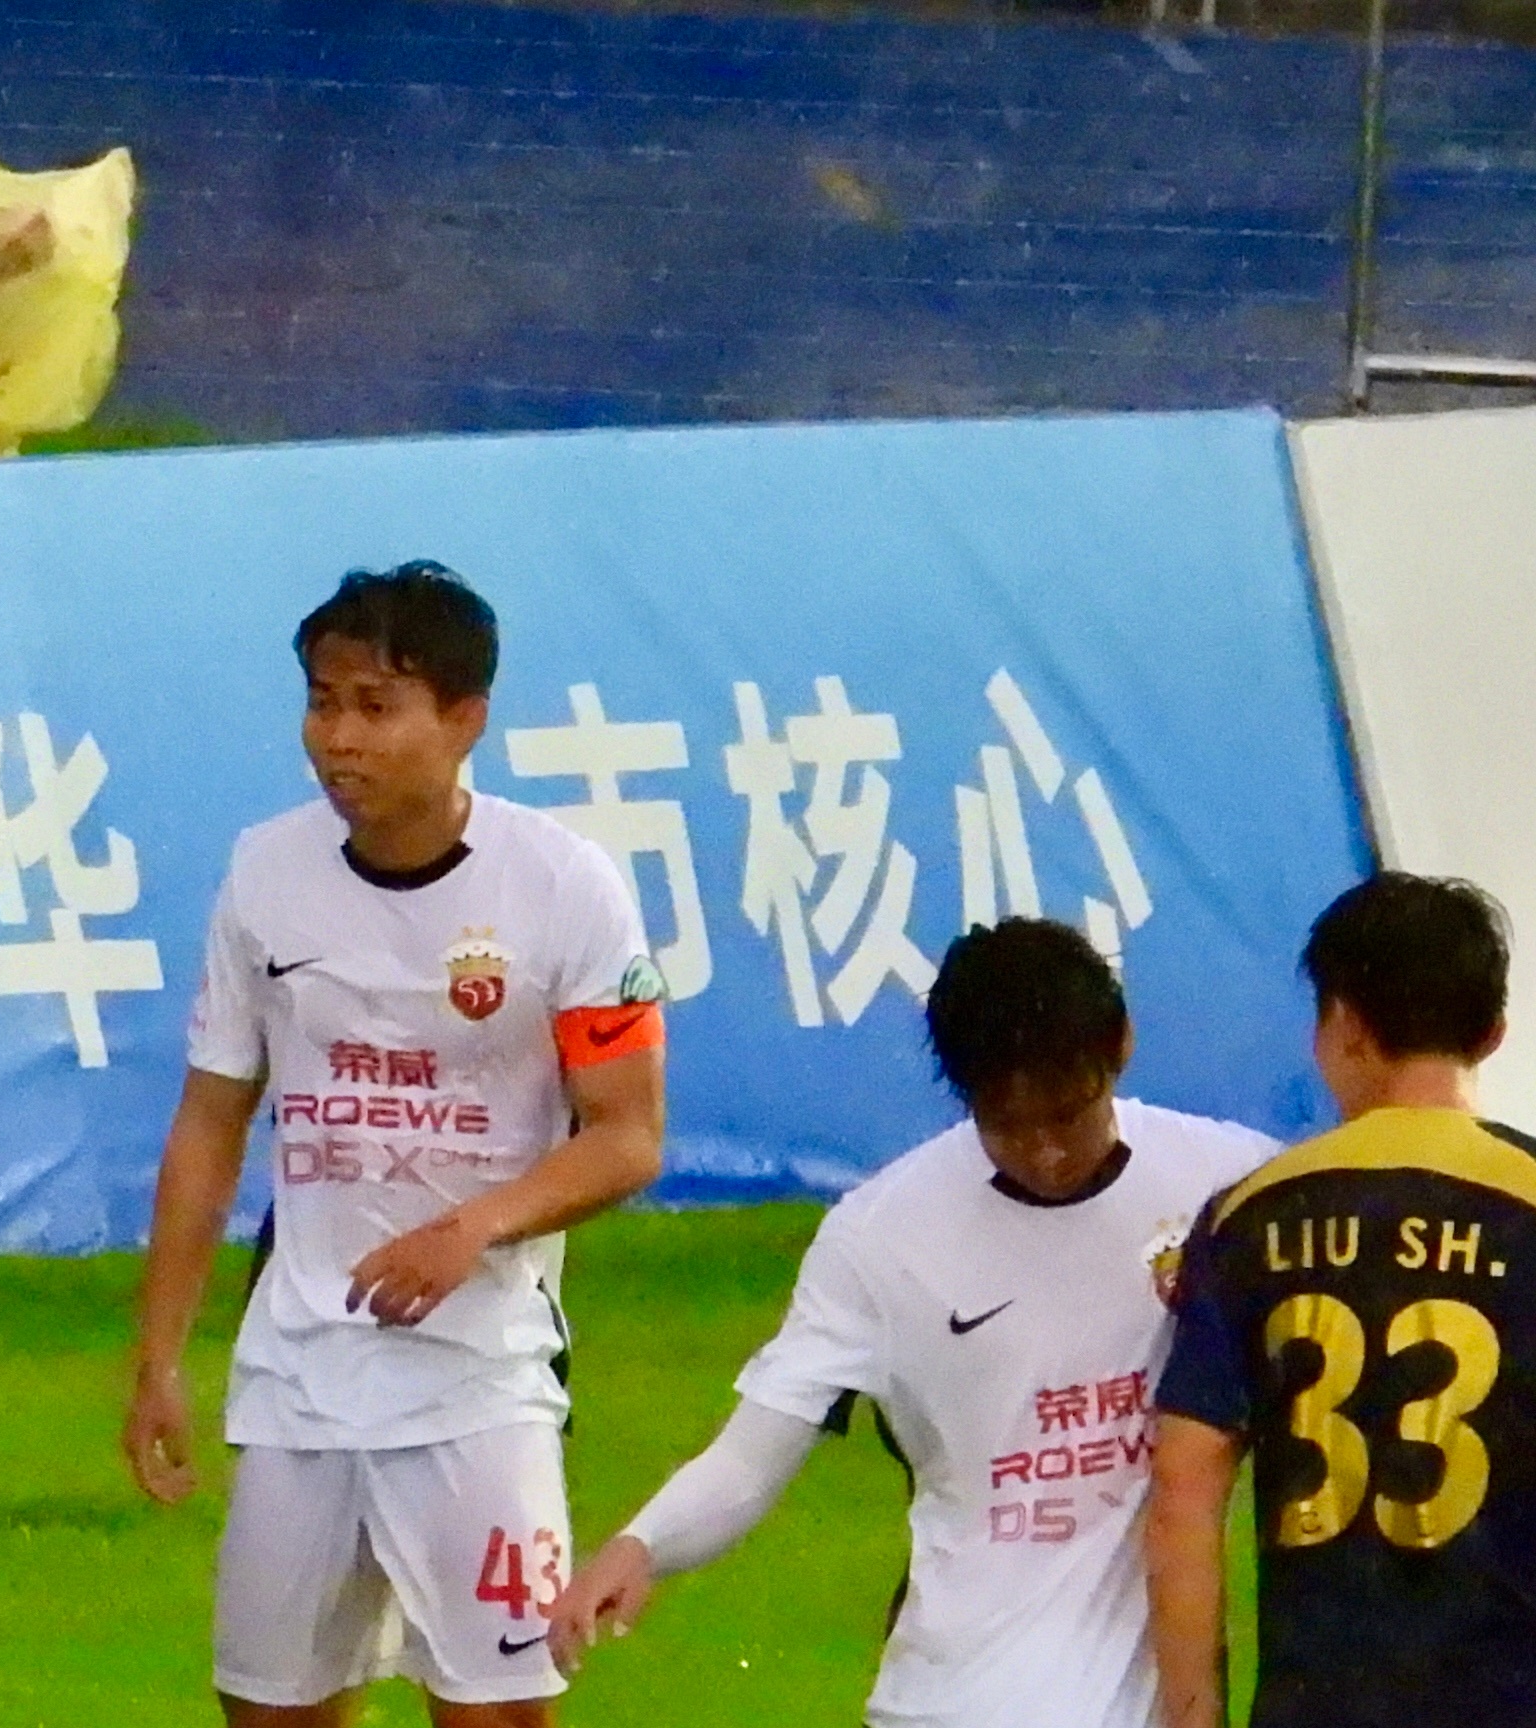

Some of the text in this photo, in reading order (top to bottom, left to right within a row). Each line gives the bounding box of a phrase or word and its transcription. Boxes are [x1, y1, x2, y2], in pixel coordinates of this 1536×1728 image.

[306, 666, 1153, 1028] 市核心
[330, 1039, 439, 1090] 荣威
[283, 1093, 490, 1135] ROEWE
[1266, 1216, 1506, 1277] LIU SH.
[1035, 1368, 1154, 1434] 荣威
[1266, 1292, 1500, 1549] 33
[990, 1432, 1155, 1490] ROEW
